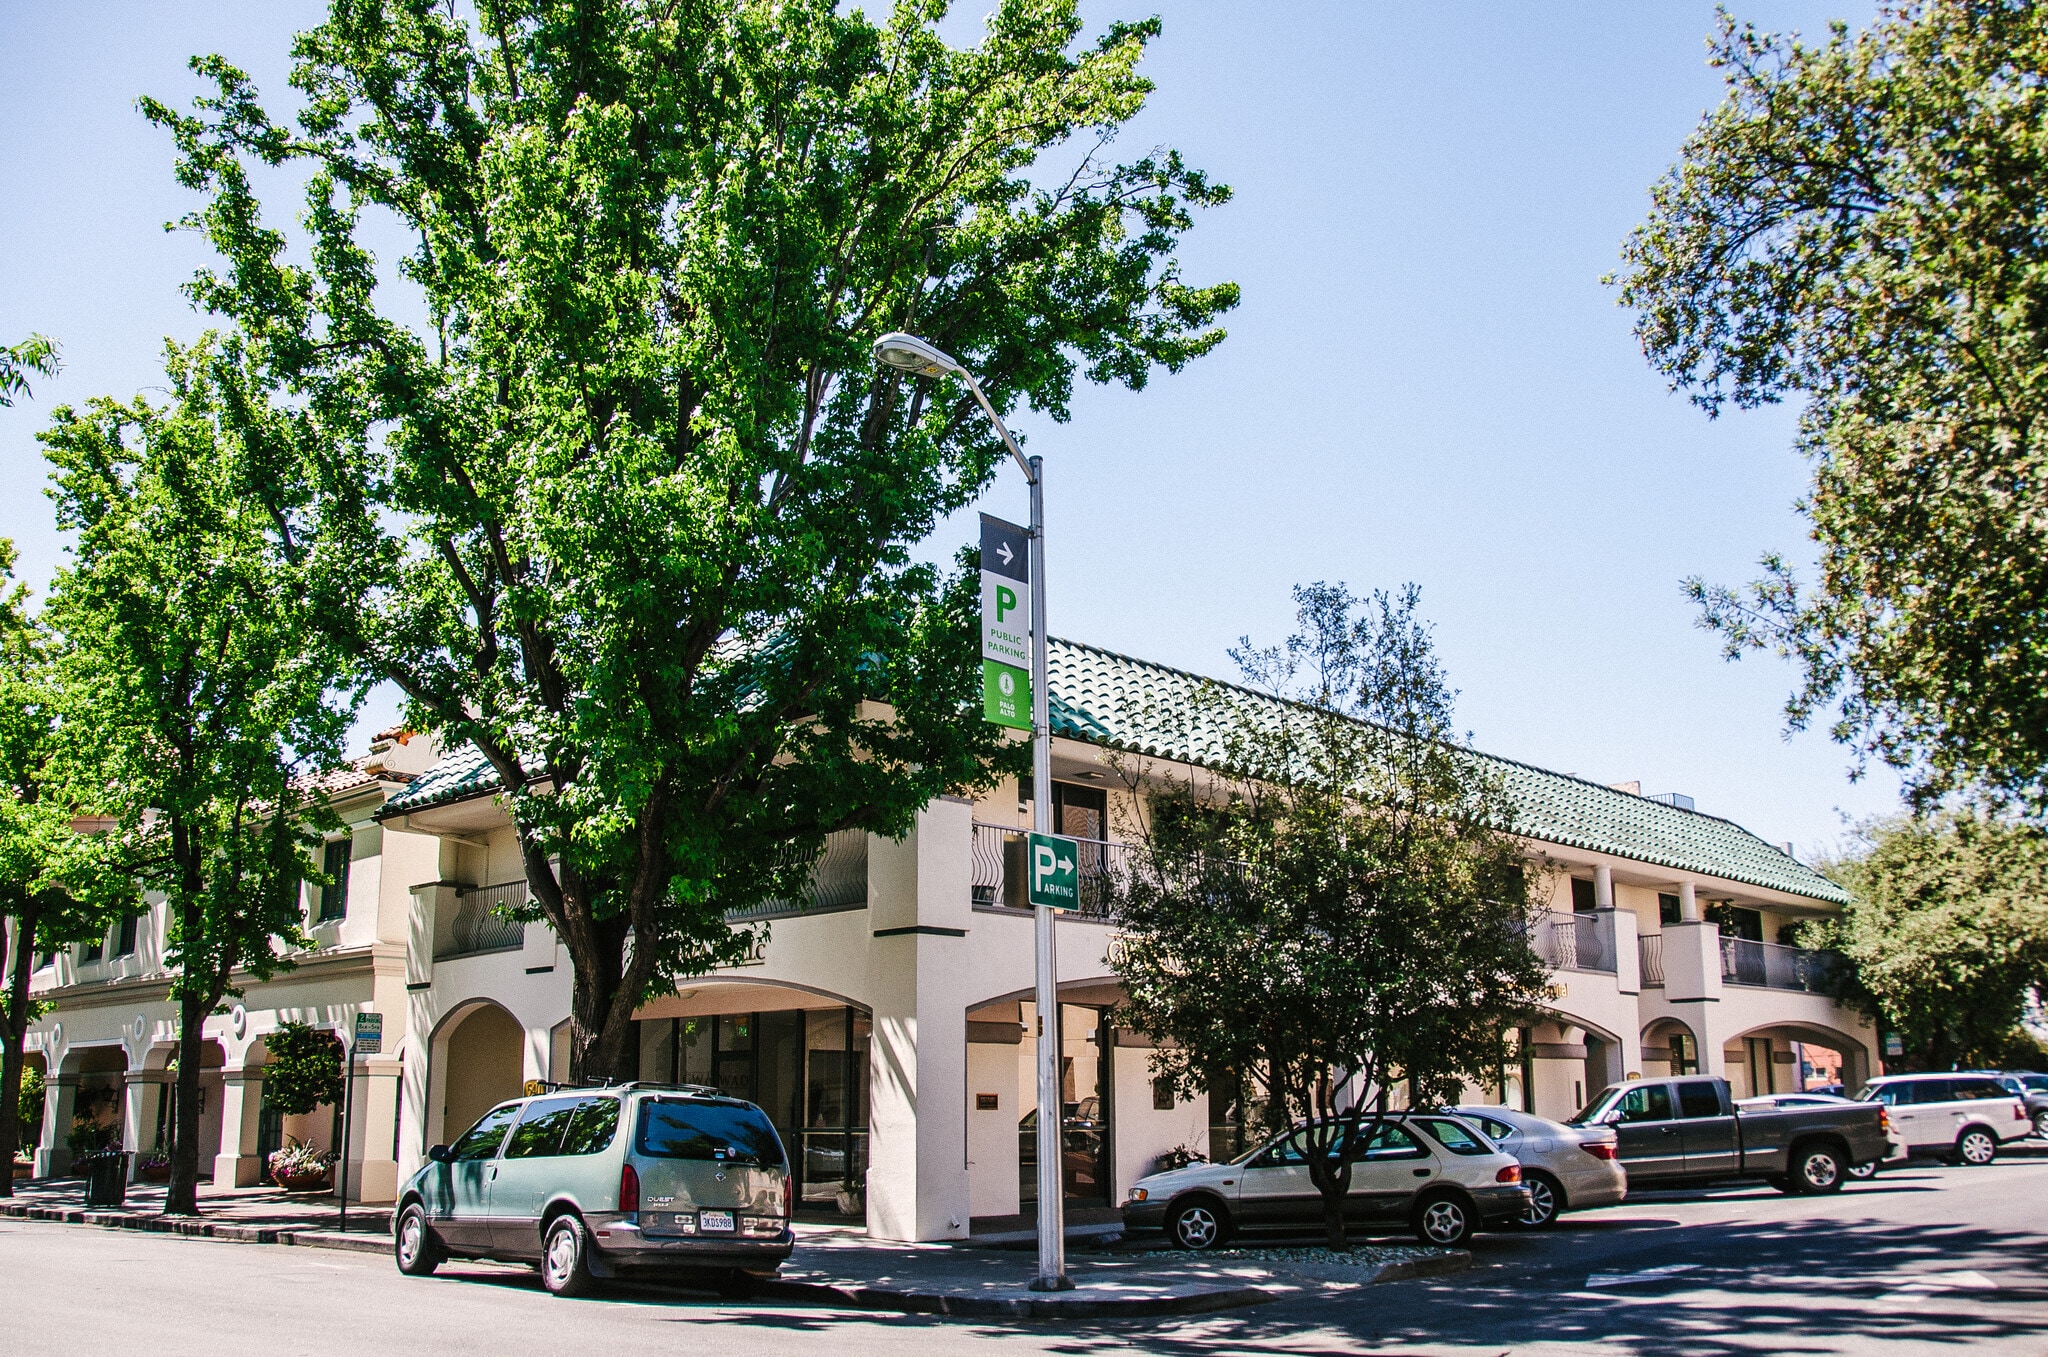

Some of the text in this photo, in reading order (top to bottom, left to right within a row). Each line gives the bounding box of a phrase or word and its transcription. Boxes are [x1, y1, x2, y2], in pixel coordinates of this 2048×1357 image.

[996, 584, 1017, 623] P
[990, 628, 1022, 645] PUBLIC
[987, 641, 1026, 660] PARKING
[999, 700, 1015, 710] PALO
[999, 708, 1016, 718] ALTO
